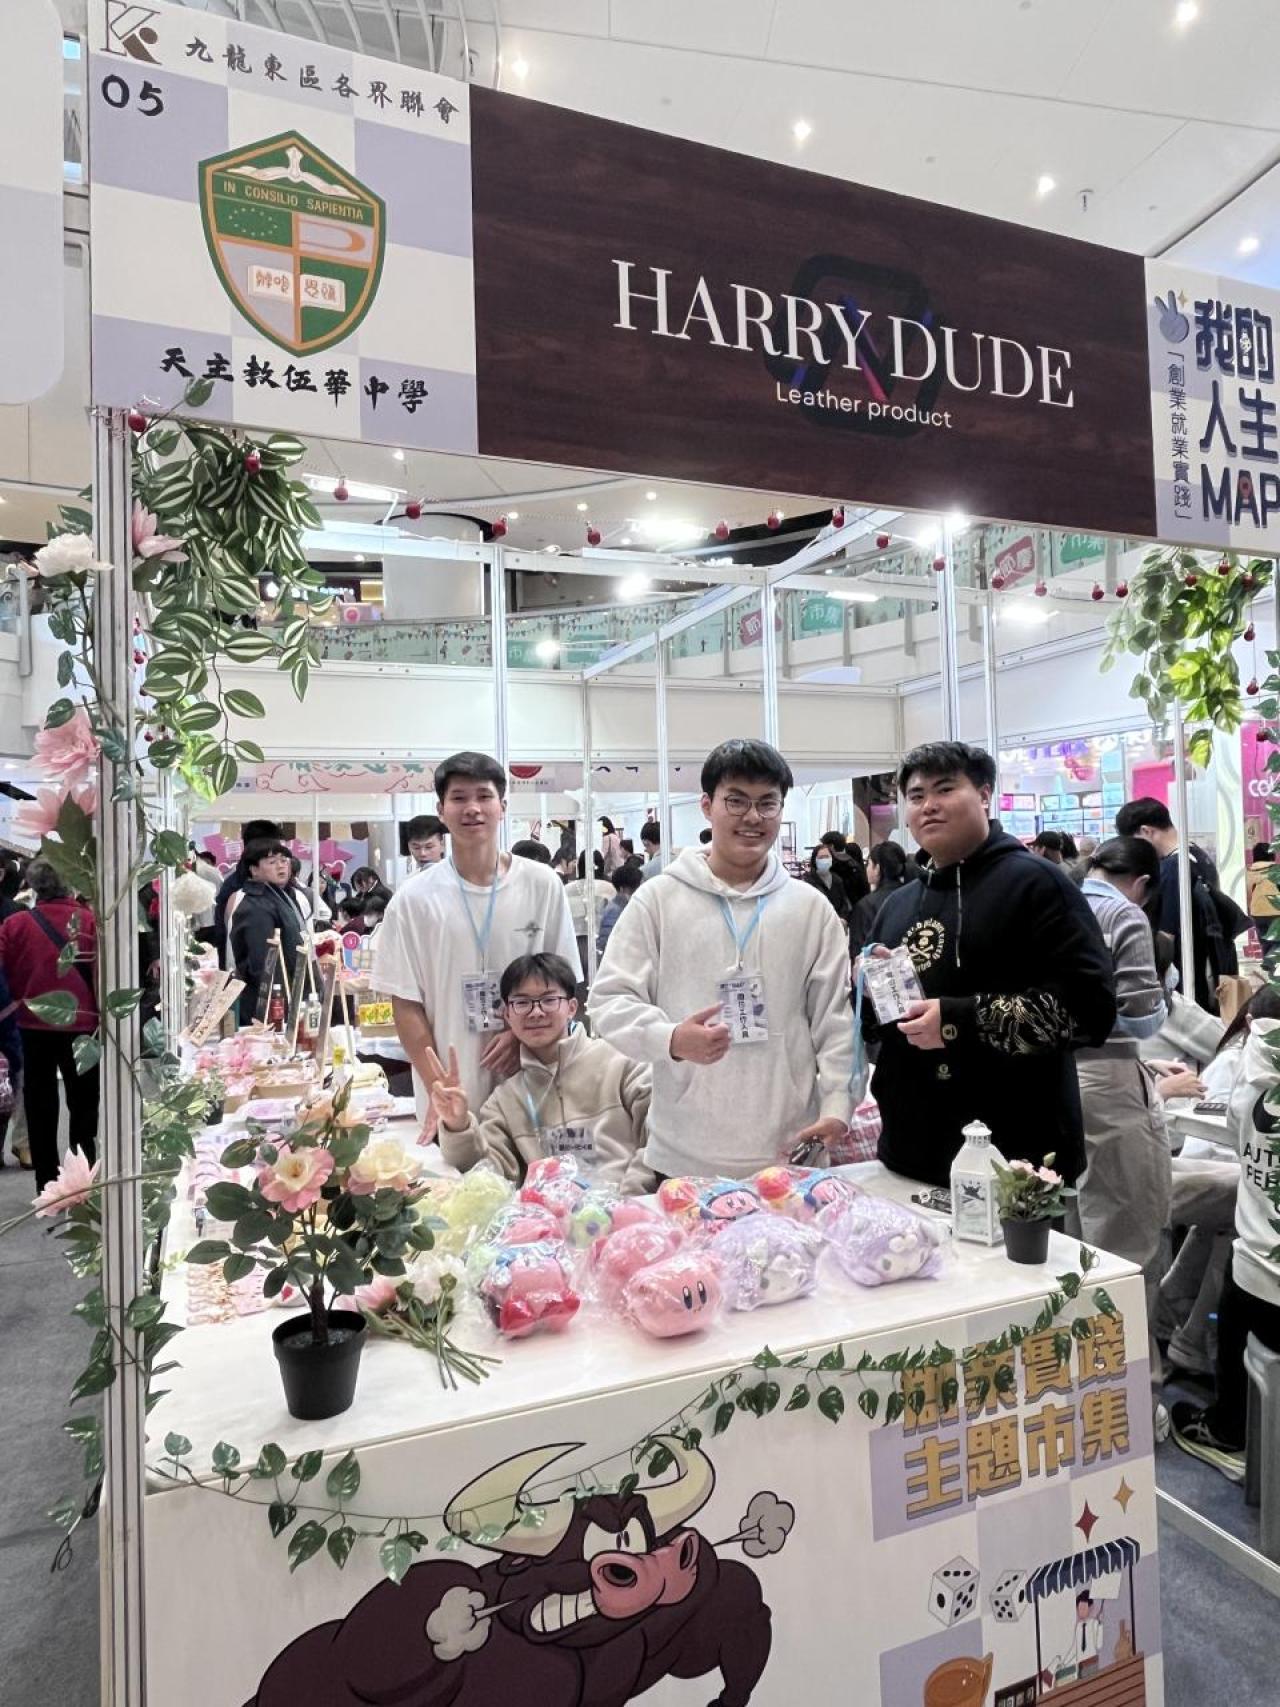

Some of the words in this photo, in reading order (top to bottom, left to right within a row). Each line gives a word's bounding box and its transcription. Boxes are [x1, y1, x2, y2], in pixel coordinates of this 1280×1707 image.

[101, 74, 164, 116] 05
[185, 37, 460, 125] 九龍東區各界聯會
[223, 181, 236, 193] IN
[245, 185, 299, 207] CONSILIO
[307, 200, 364, 221] SAPIENTIA
[611, 259, 871, 371] HARRY
[888, 315, 1075, 408] DUDE
[1194, 299, 1274, 384] 我的
[160, 347, 429, 414] 天主教伍華中學
[776, 382, 861, 414] Leather
[867, 399, 953, 428] product
[1199, 380, 1279, 464] 人生
[1200, 463, 1280, 528] MAP
[904, 1388, 1131, 1521] 主題市集
